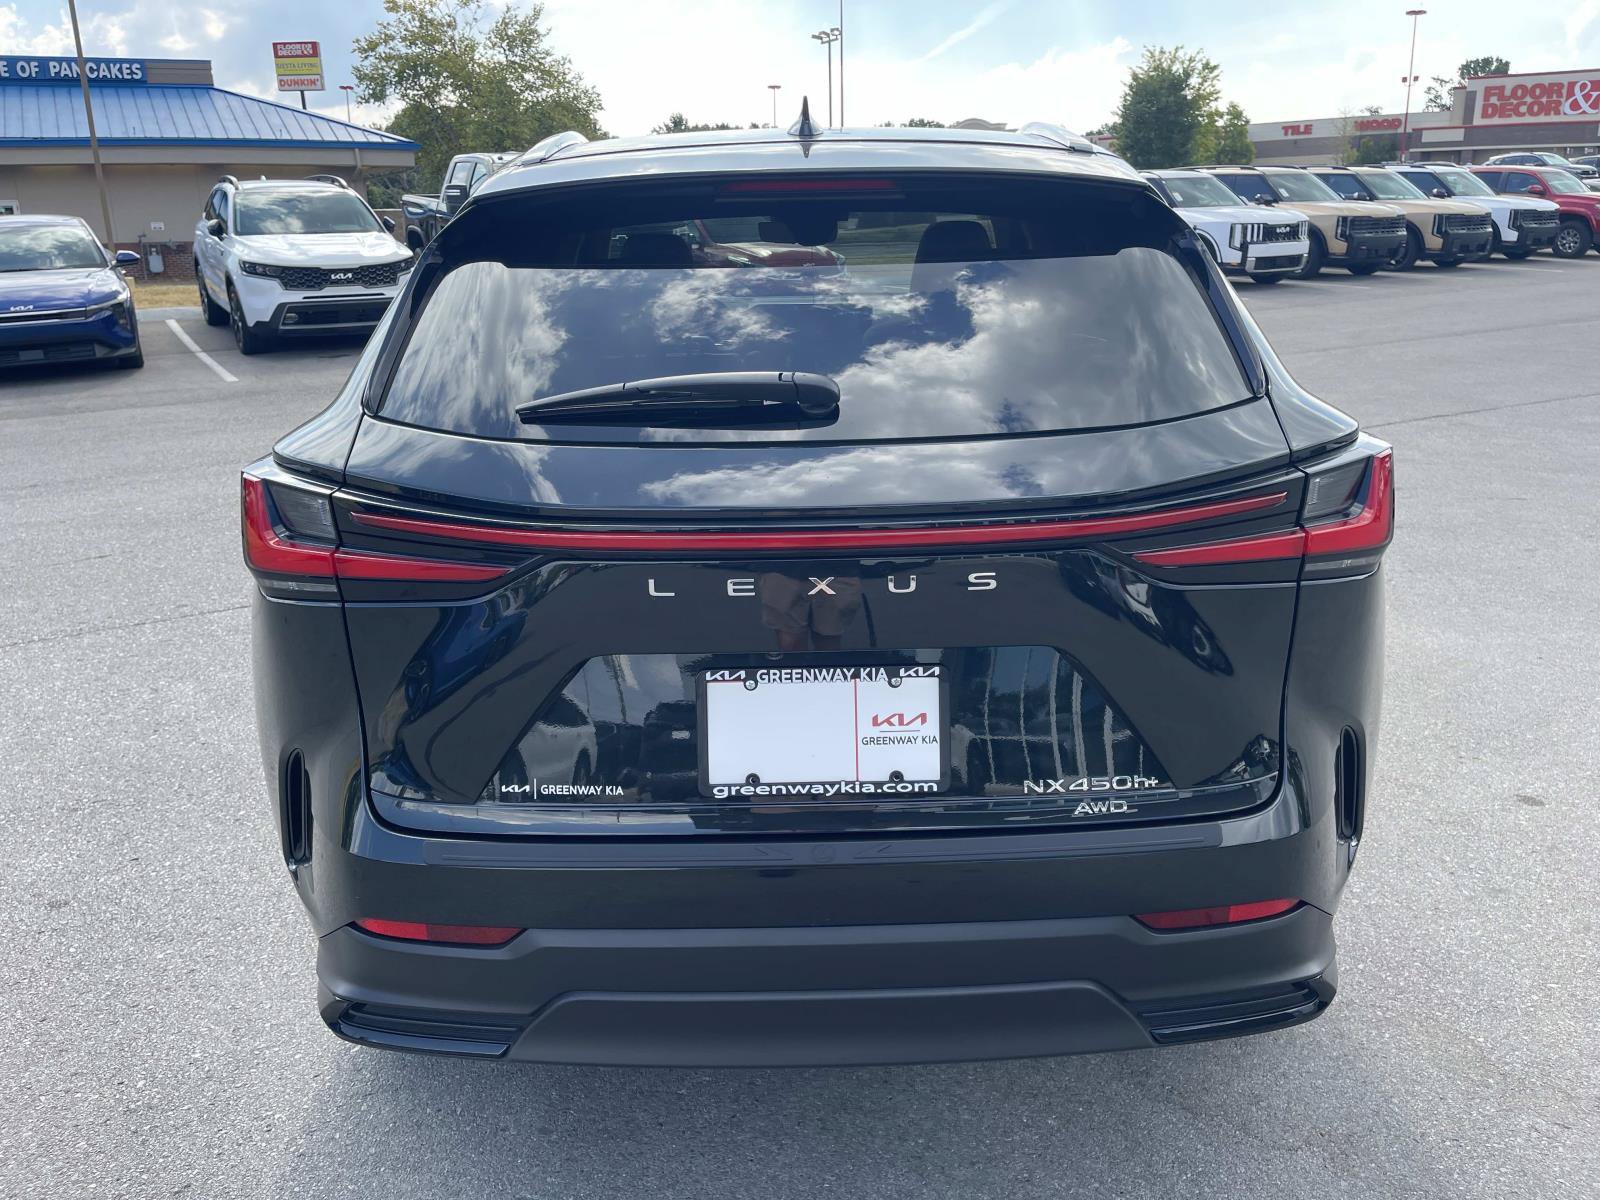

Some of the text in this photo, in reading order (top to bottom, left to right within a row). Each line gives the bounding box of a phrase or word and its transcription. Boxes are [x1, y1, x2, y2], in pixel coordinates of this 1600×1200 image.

[16, 61, 40, 78] OF
[279, 78, 319, 87] DUNKIN'
[1483, 82, 1565, 102] FLOOR
[1481, 100, 1562, 119] DECOR
[1281, 118, 1402, 136] TILE WOOD
[331, 272, 353, 280] KIA
[647, 572, 998, 597] LEXUS
[705, 666, 940, 684] KIA GREENWAY KIA KIA
[871, 712, 928, 728] KIA
[861, 734, 939, 746] GREENWAY KIA
[501, 784, 624, 796] KIA GREENWAY KIA
[712, 780, 938, 799] greenwaykia.com
[1074, 800, 1128, 815] AWD
